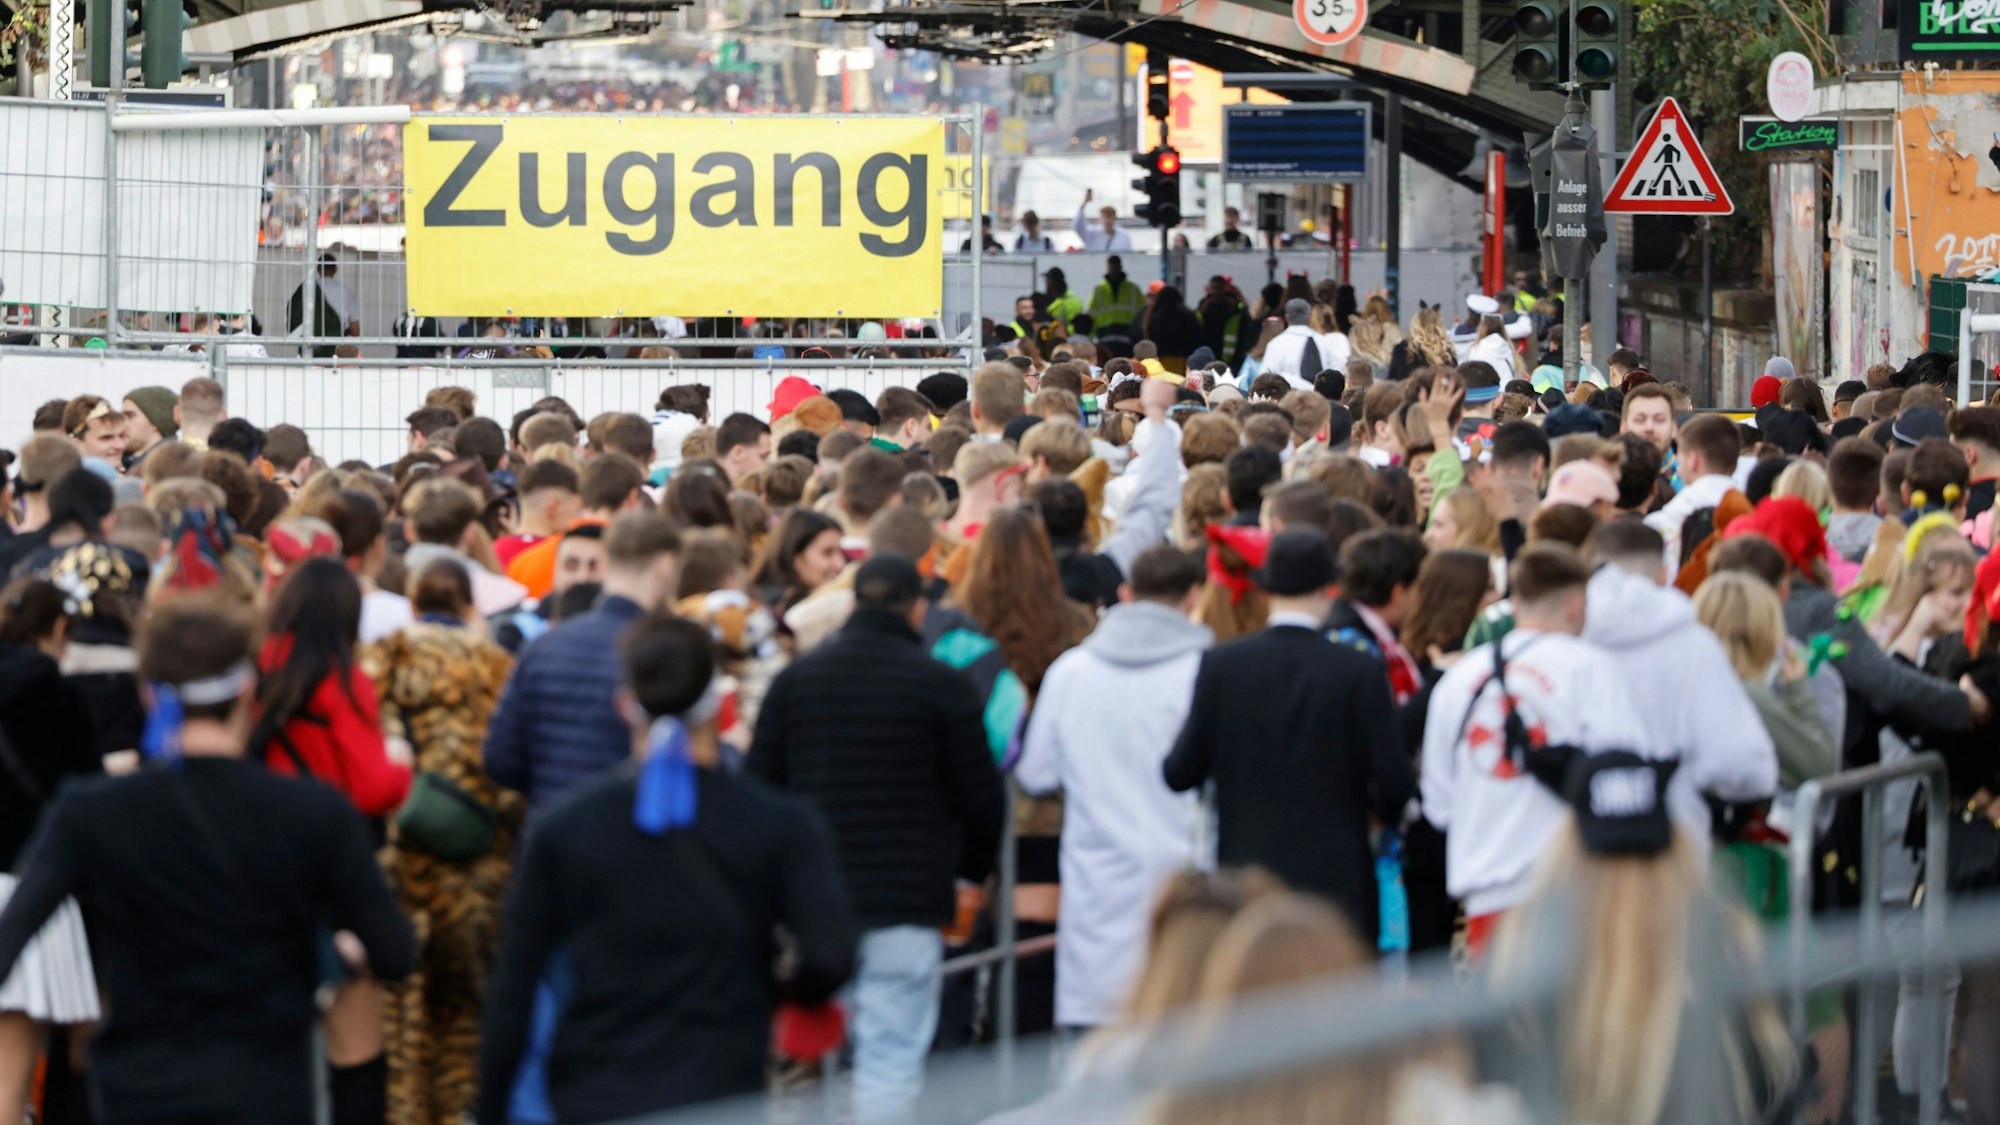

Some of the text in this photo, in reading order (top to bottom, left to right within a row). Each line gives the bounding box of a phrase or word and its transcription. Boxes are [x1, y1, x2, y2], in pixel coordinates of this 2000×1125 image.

[1746, 122, 1836, 151] Station
[423, 124, 928, 257] Zugang
[1557, 179, 1588, 196] Anlage
[1556, 203, 1588, 214] ausser
[1556, 223, 1588, 237] Betrieb
